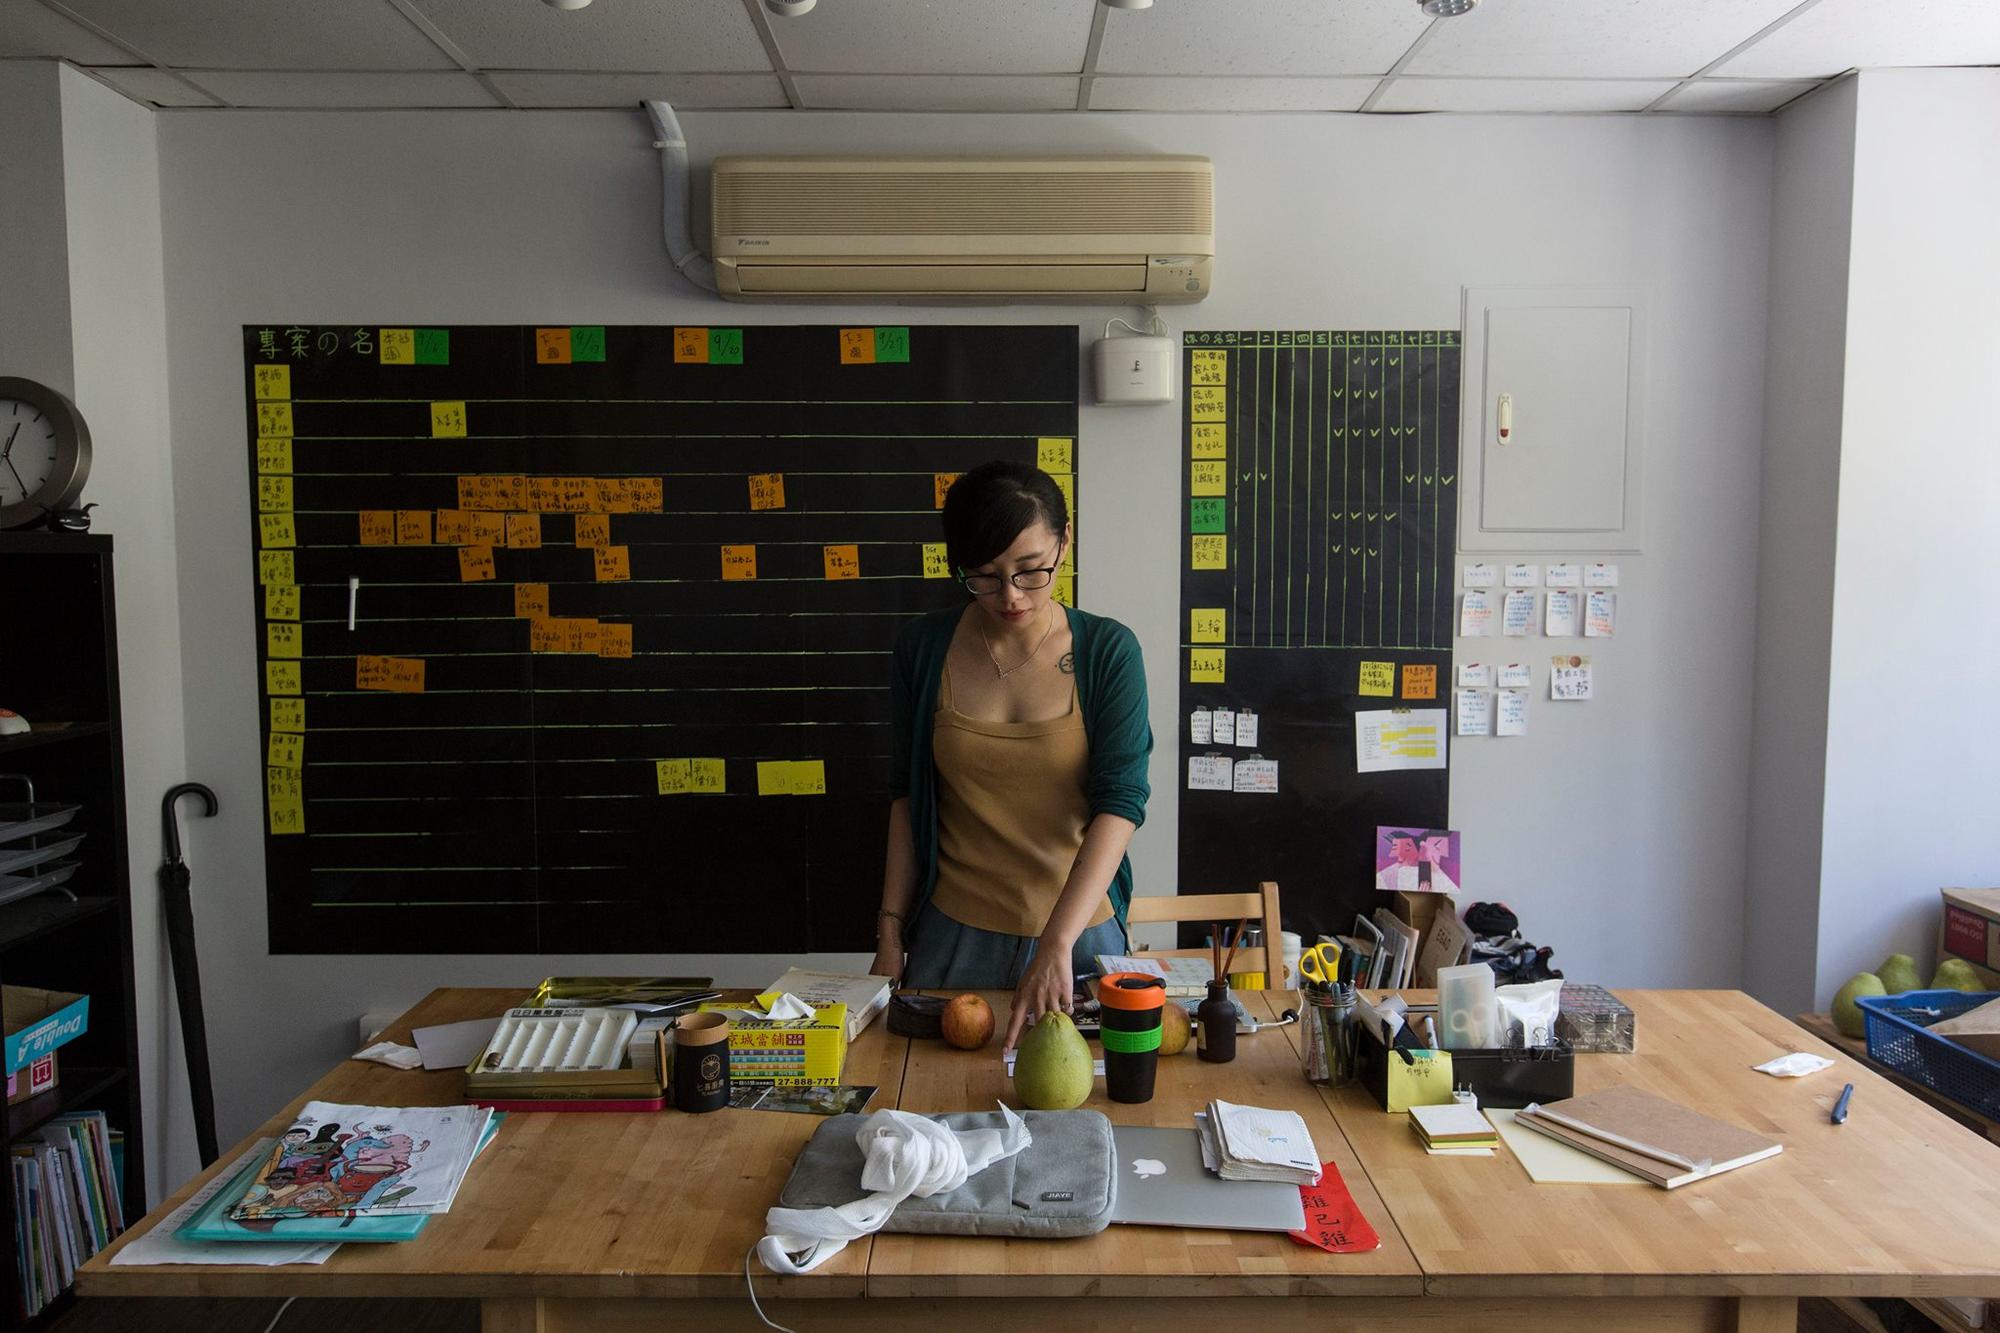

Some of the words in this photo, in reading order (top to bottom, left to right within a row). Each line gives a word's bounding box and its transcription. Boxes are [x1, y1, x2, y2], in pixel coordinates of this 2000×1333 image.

[33, 1014, 82, 1051] Double
[17, 1042, 29, 1063] A
[777, 1078, 836, 1086] 27-888-777
